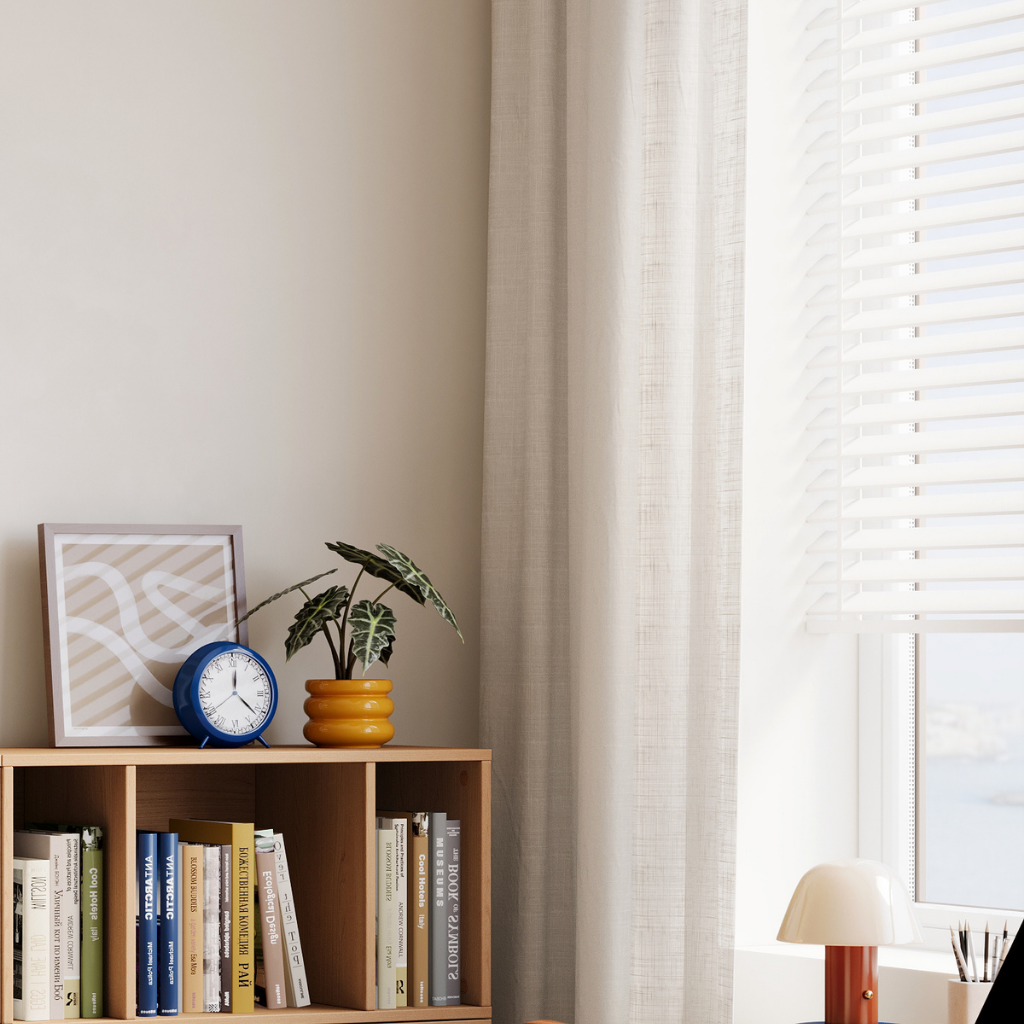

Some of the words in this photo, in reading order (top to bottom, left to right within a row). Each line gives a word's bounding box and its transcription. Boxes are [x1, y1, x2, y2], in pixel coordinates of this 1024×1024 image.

[239, 848, 249, 913] БОЖЕСТВЕННАЯ
[436, 838, 444, 907] MUSEUMS
[54, 890, 63, 926] Уличный
[417, 914, 425, 929] Italy
[54, 945, 60, 955] по
[238, 916, 249, 956] КОМЕДИЯ
[238, 963, 252, 987] РАЙ
[54, 984, 63, 1000] Боб
